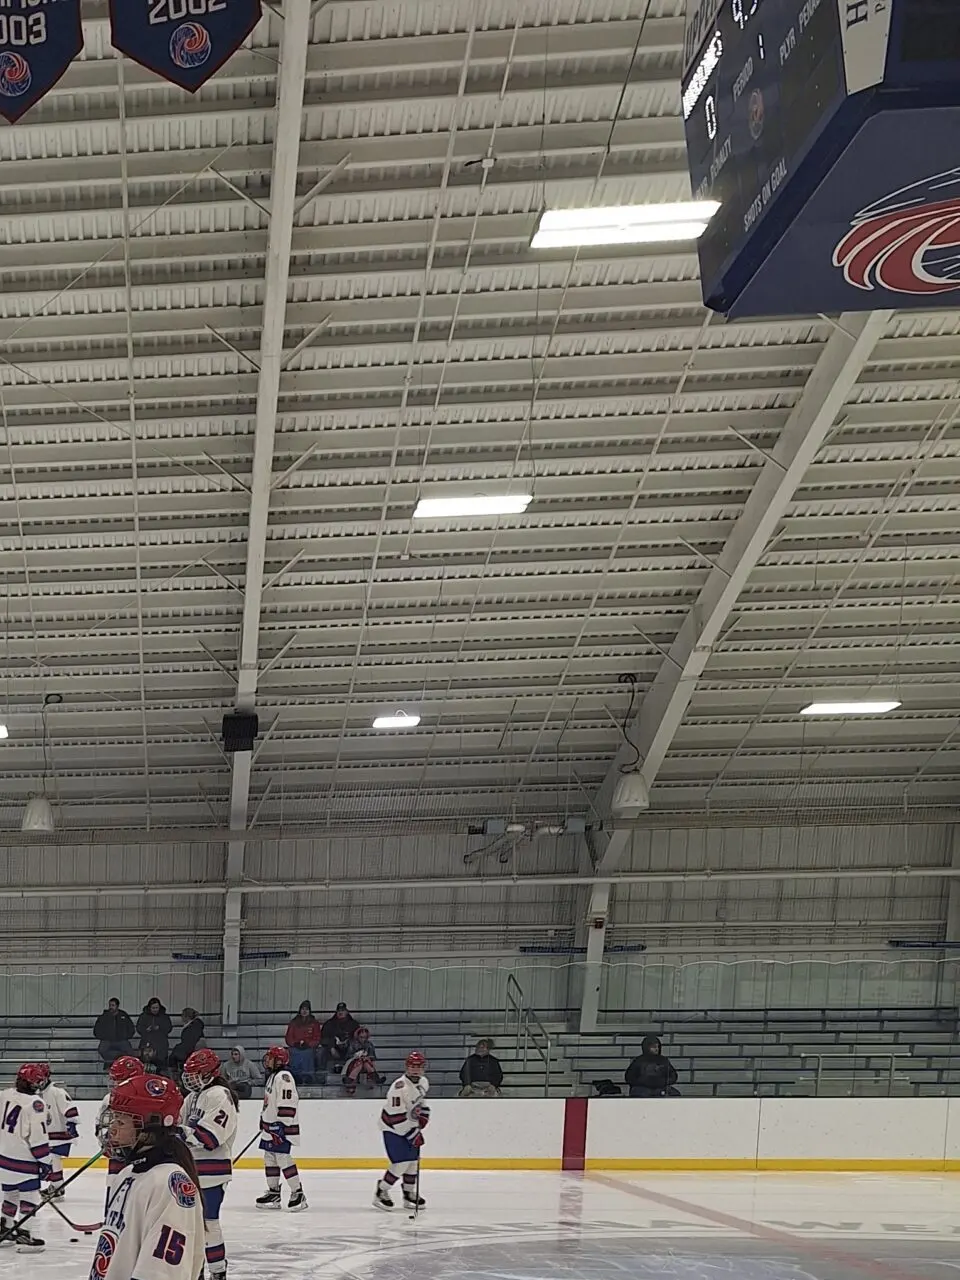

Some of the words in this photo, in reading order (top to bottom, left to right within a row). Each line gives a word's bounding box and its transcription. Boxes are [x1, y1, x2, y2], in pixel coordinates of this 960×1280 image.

[732, 56, 754, 102] PERIOD
[743, 193, 763, 233] SHOTS
[761, 179, 772, 206] ON
[770, 157, 788, 192] GOAL
[1, 1100, 23, 1134] 14
[213, 1109, 229, 1129] 21
[151, 1223, 188, 1267] 15
